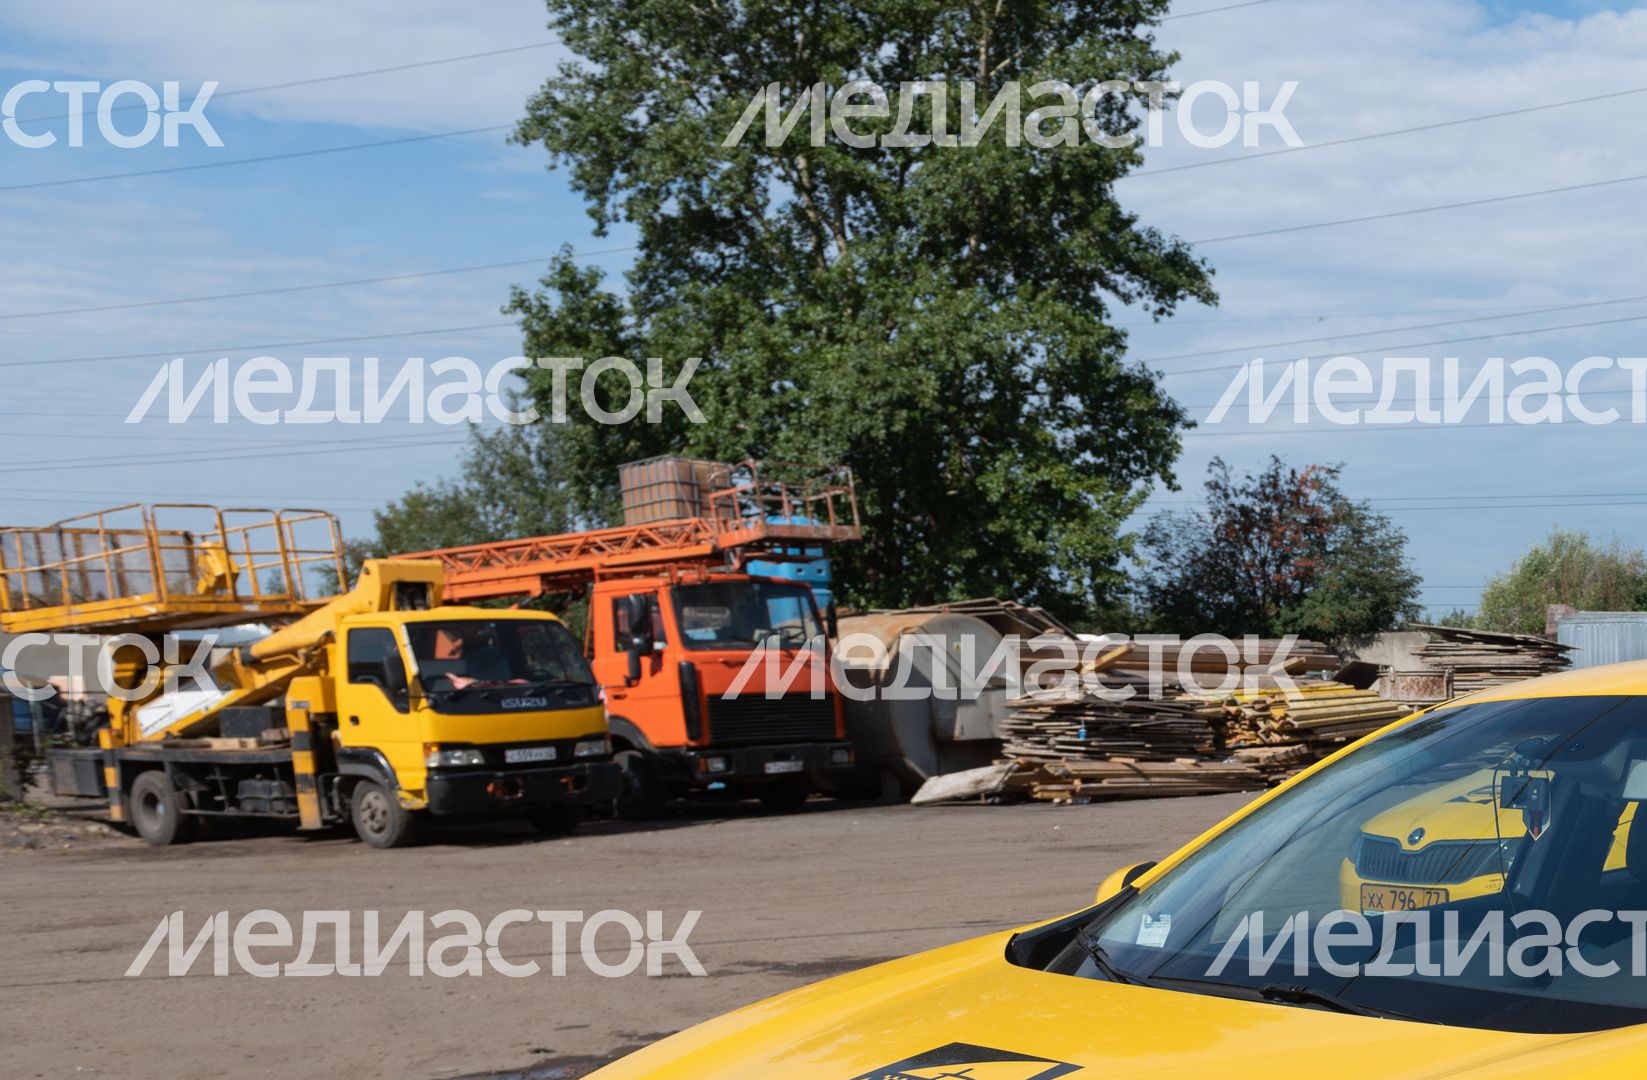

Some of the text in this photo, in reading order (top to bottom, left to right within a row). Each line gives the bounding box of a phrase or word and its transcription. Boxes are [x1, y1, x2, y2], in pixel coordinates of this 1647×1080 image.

[501, 697, 548, 709] ISUZU
[1389, 889, 1416, 911] 796
[1425, 891, 1441, 906] 77
